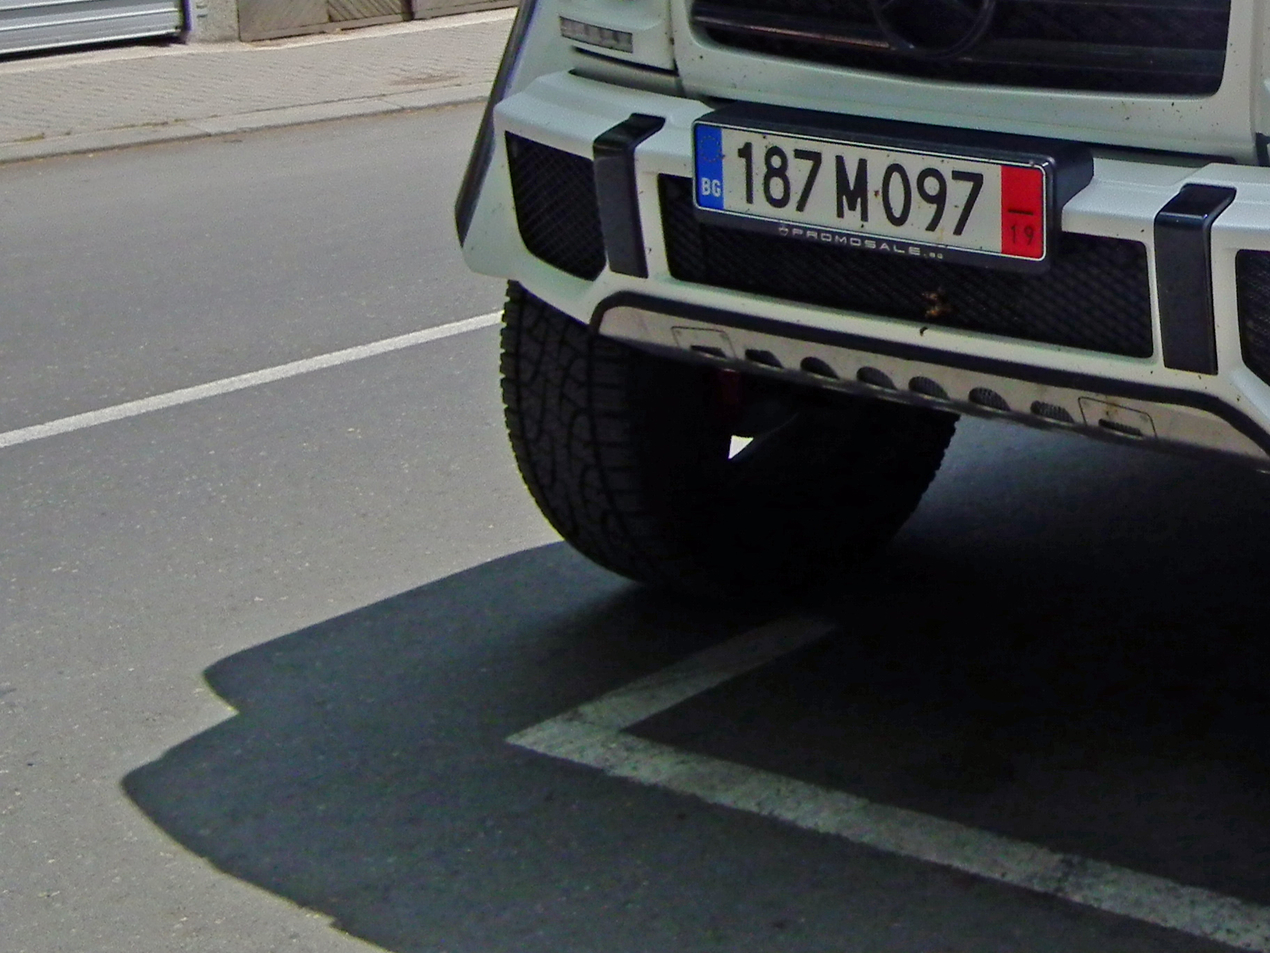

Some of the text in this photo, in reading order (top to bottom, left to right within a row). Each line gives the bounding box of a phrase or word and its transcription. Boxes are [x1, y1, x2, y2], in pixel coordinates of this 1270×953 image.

[701, 177, 721, 197] BG
[737, 141, 984, 236] 187 M 097
[1009, 224, 1035, 246] 19
